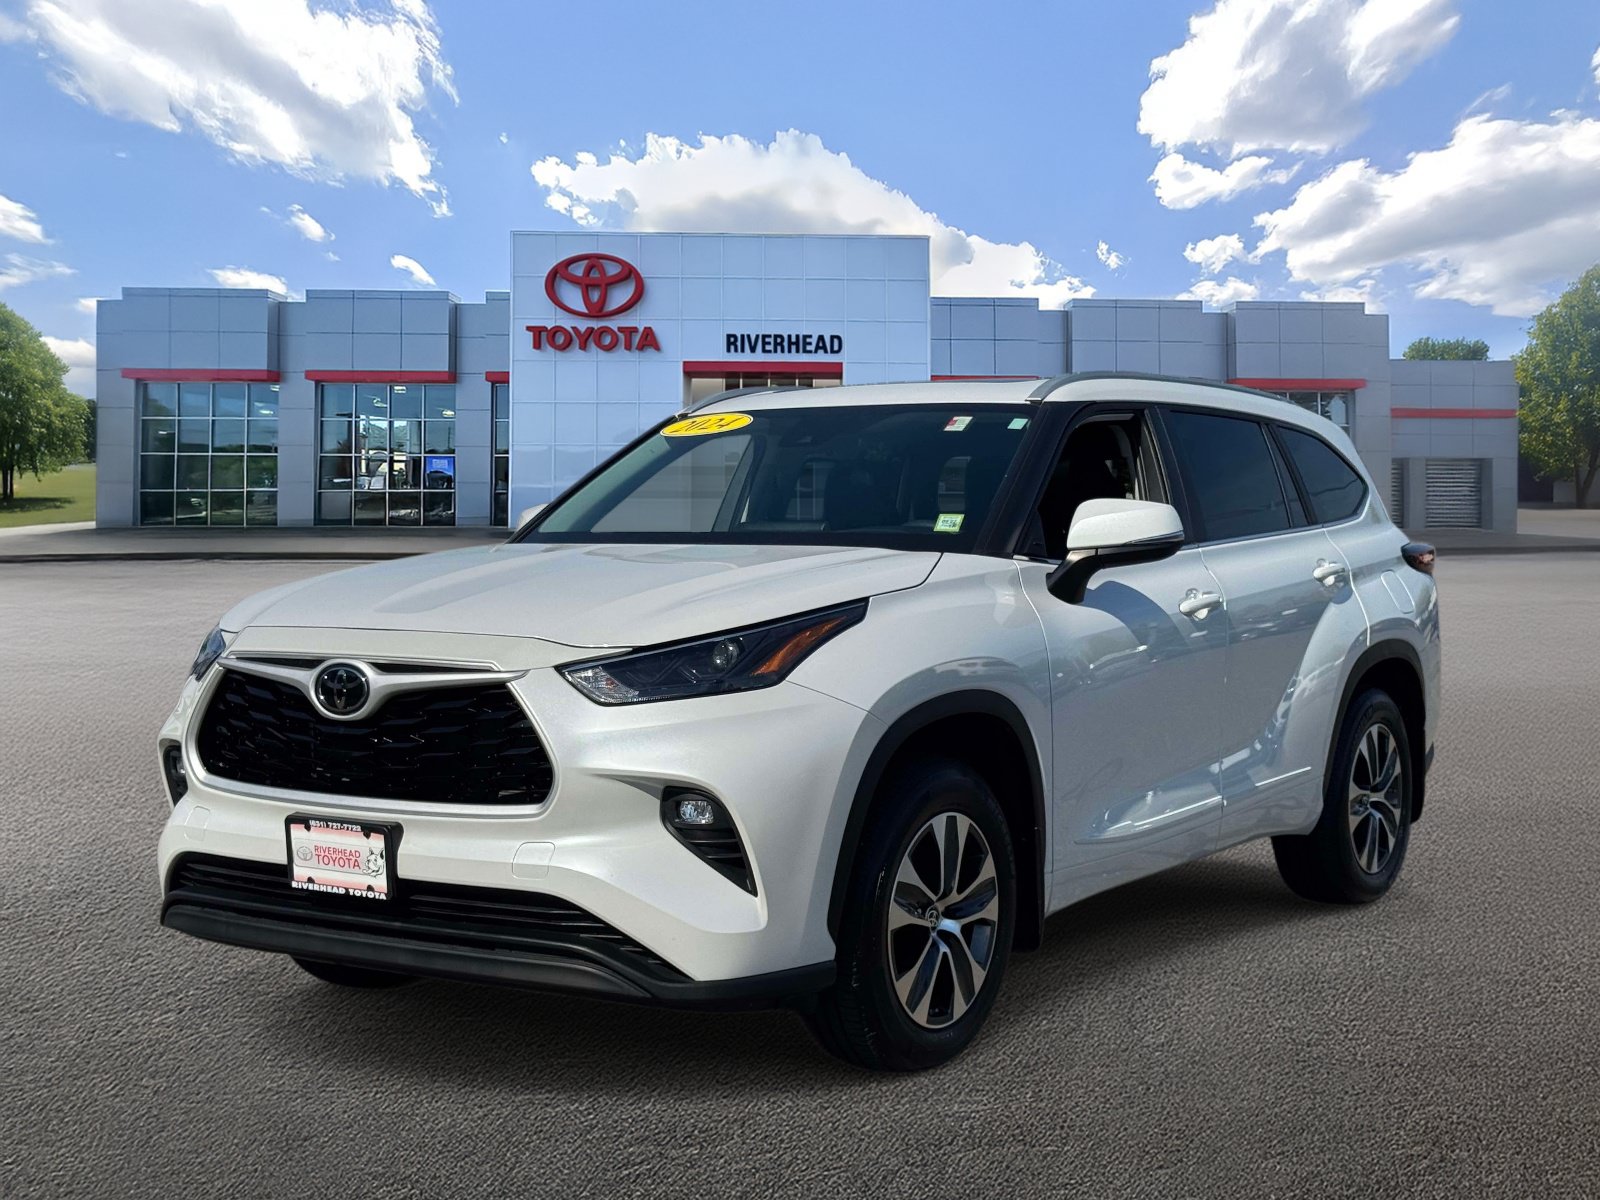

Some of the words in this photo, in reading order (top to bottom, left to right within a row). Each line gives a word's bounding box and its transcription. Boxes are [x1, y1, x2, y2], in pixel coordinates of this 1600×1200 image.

[525, 325, 661, 351] TOYOTA
[725, 333, 843, 354] RIVERHEAD
[669, 416, 745, 434] 2024
[314, 845, 361, 859] RIVERHEAD
[315, 854, 361, 870] TOYOTA
[291, 881, 346, 895] RIVERHEAD
[348, 888, 387, 900] TOYOTA
